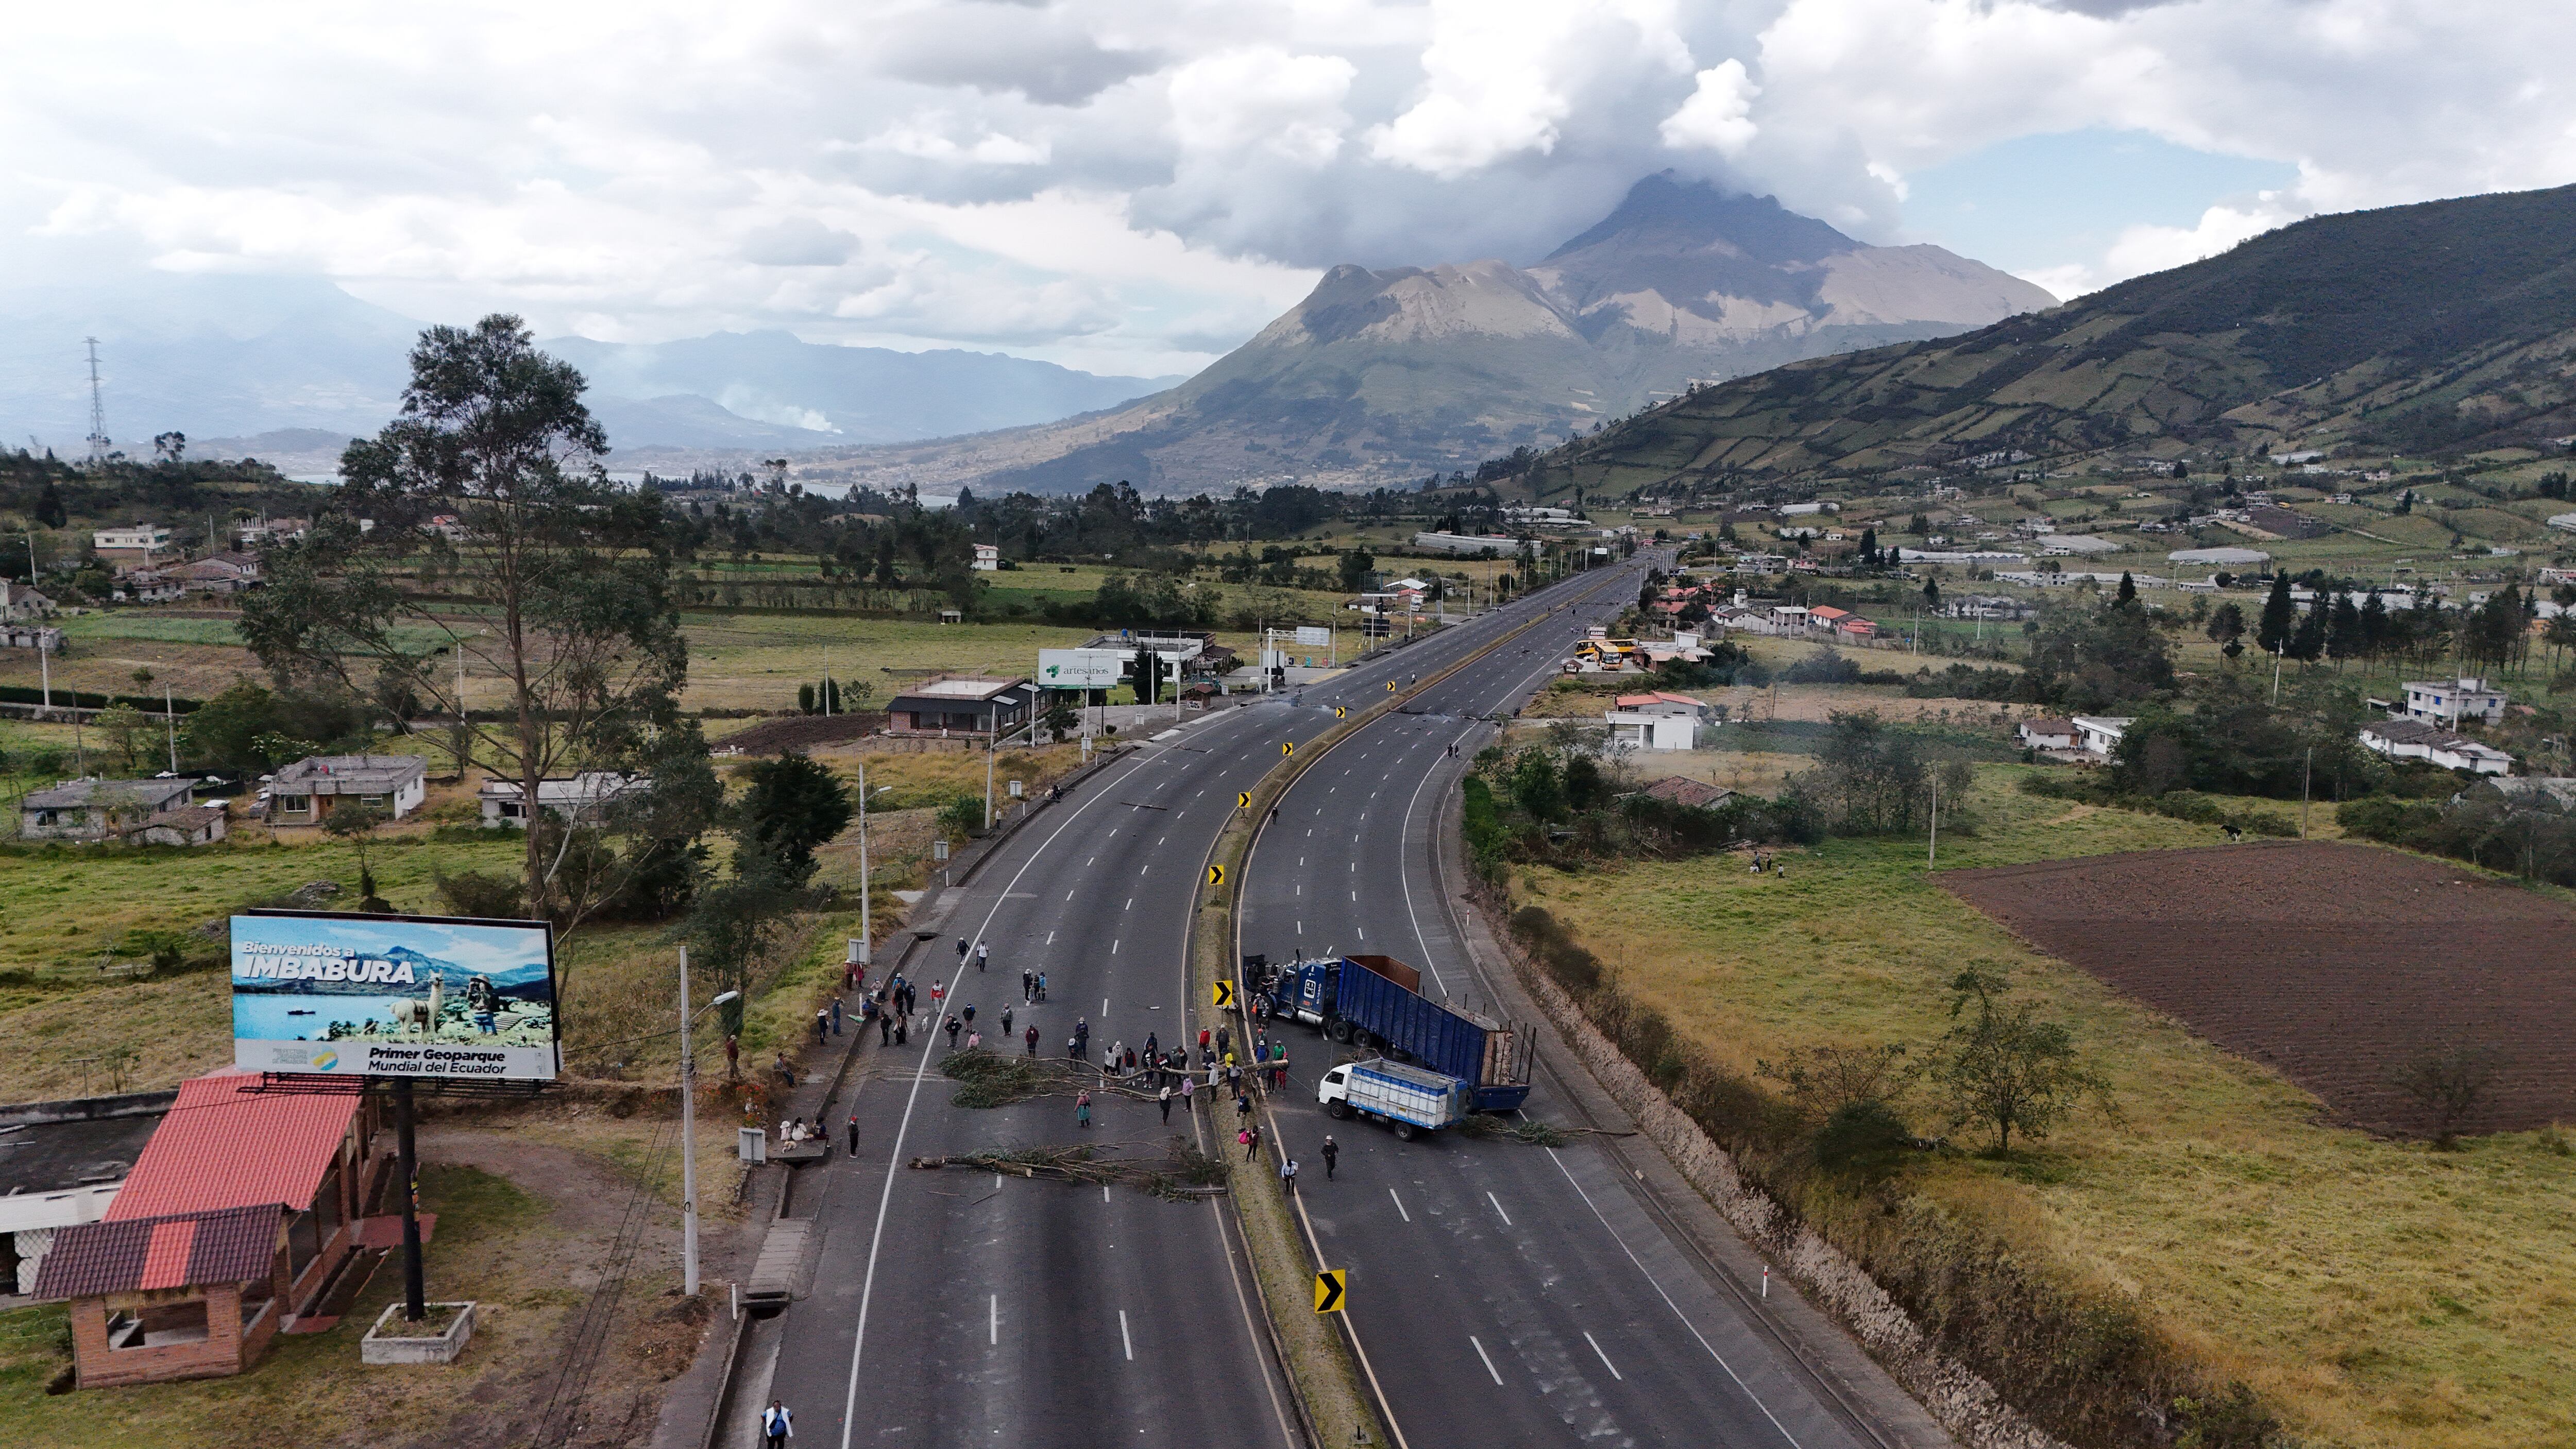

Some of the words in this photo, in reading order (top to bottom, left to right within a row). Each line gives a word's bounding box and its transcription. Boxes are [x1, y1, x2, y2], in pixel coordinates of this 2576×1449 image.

[242, 941, 342, 957] Bienvenidos
[345, 947, 355, 957] a
[241, 956, 415, 984] IMBABURA
[369, 1047, 420, 1059] Primer
[423, 1048, 505, 1062] Geoparque
[368, 1060, 422, 1072] Mundial
[425, 1062, 447, 1072] del
[450, 1062, 506, 1073] Ecuador
